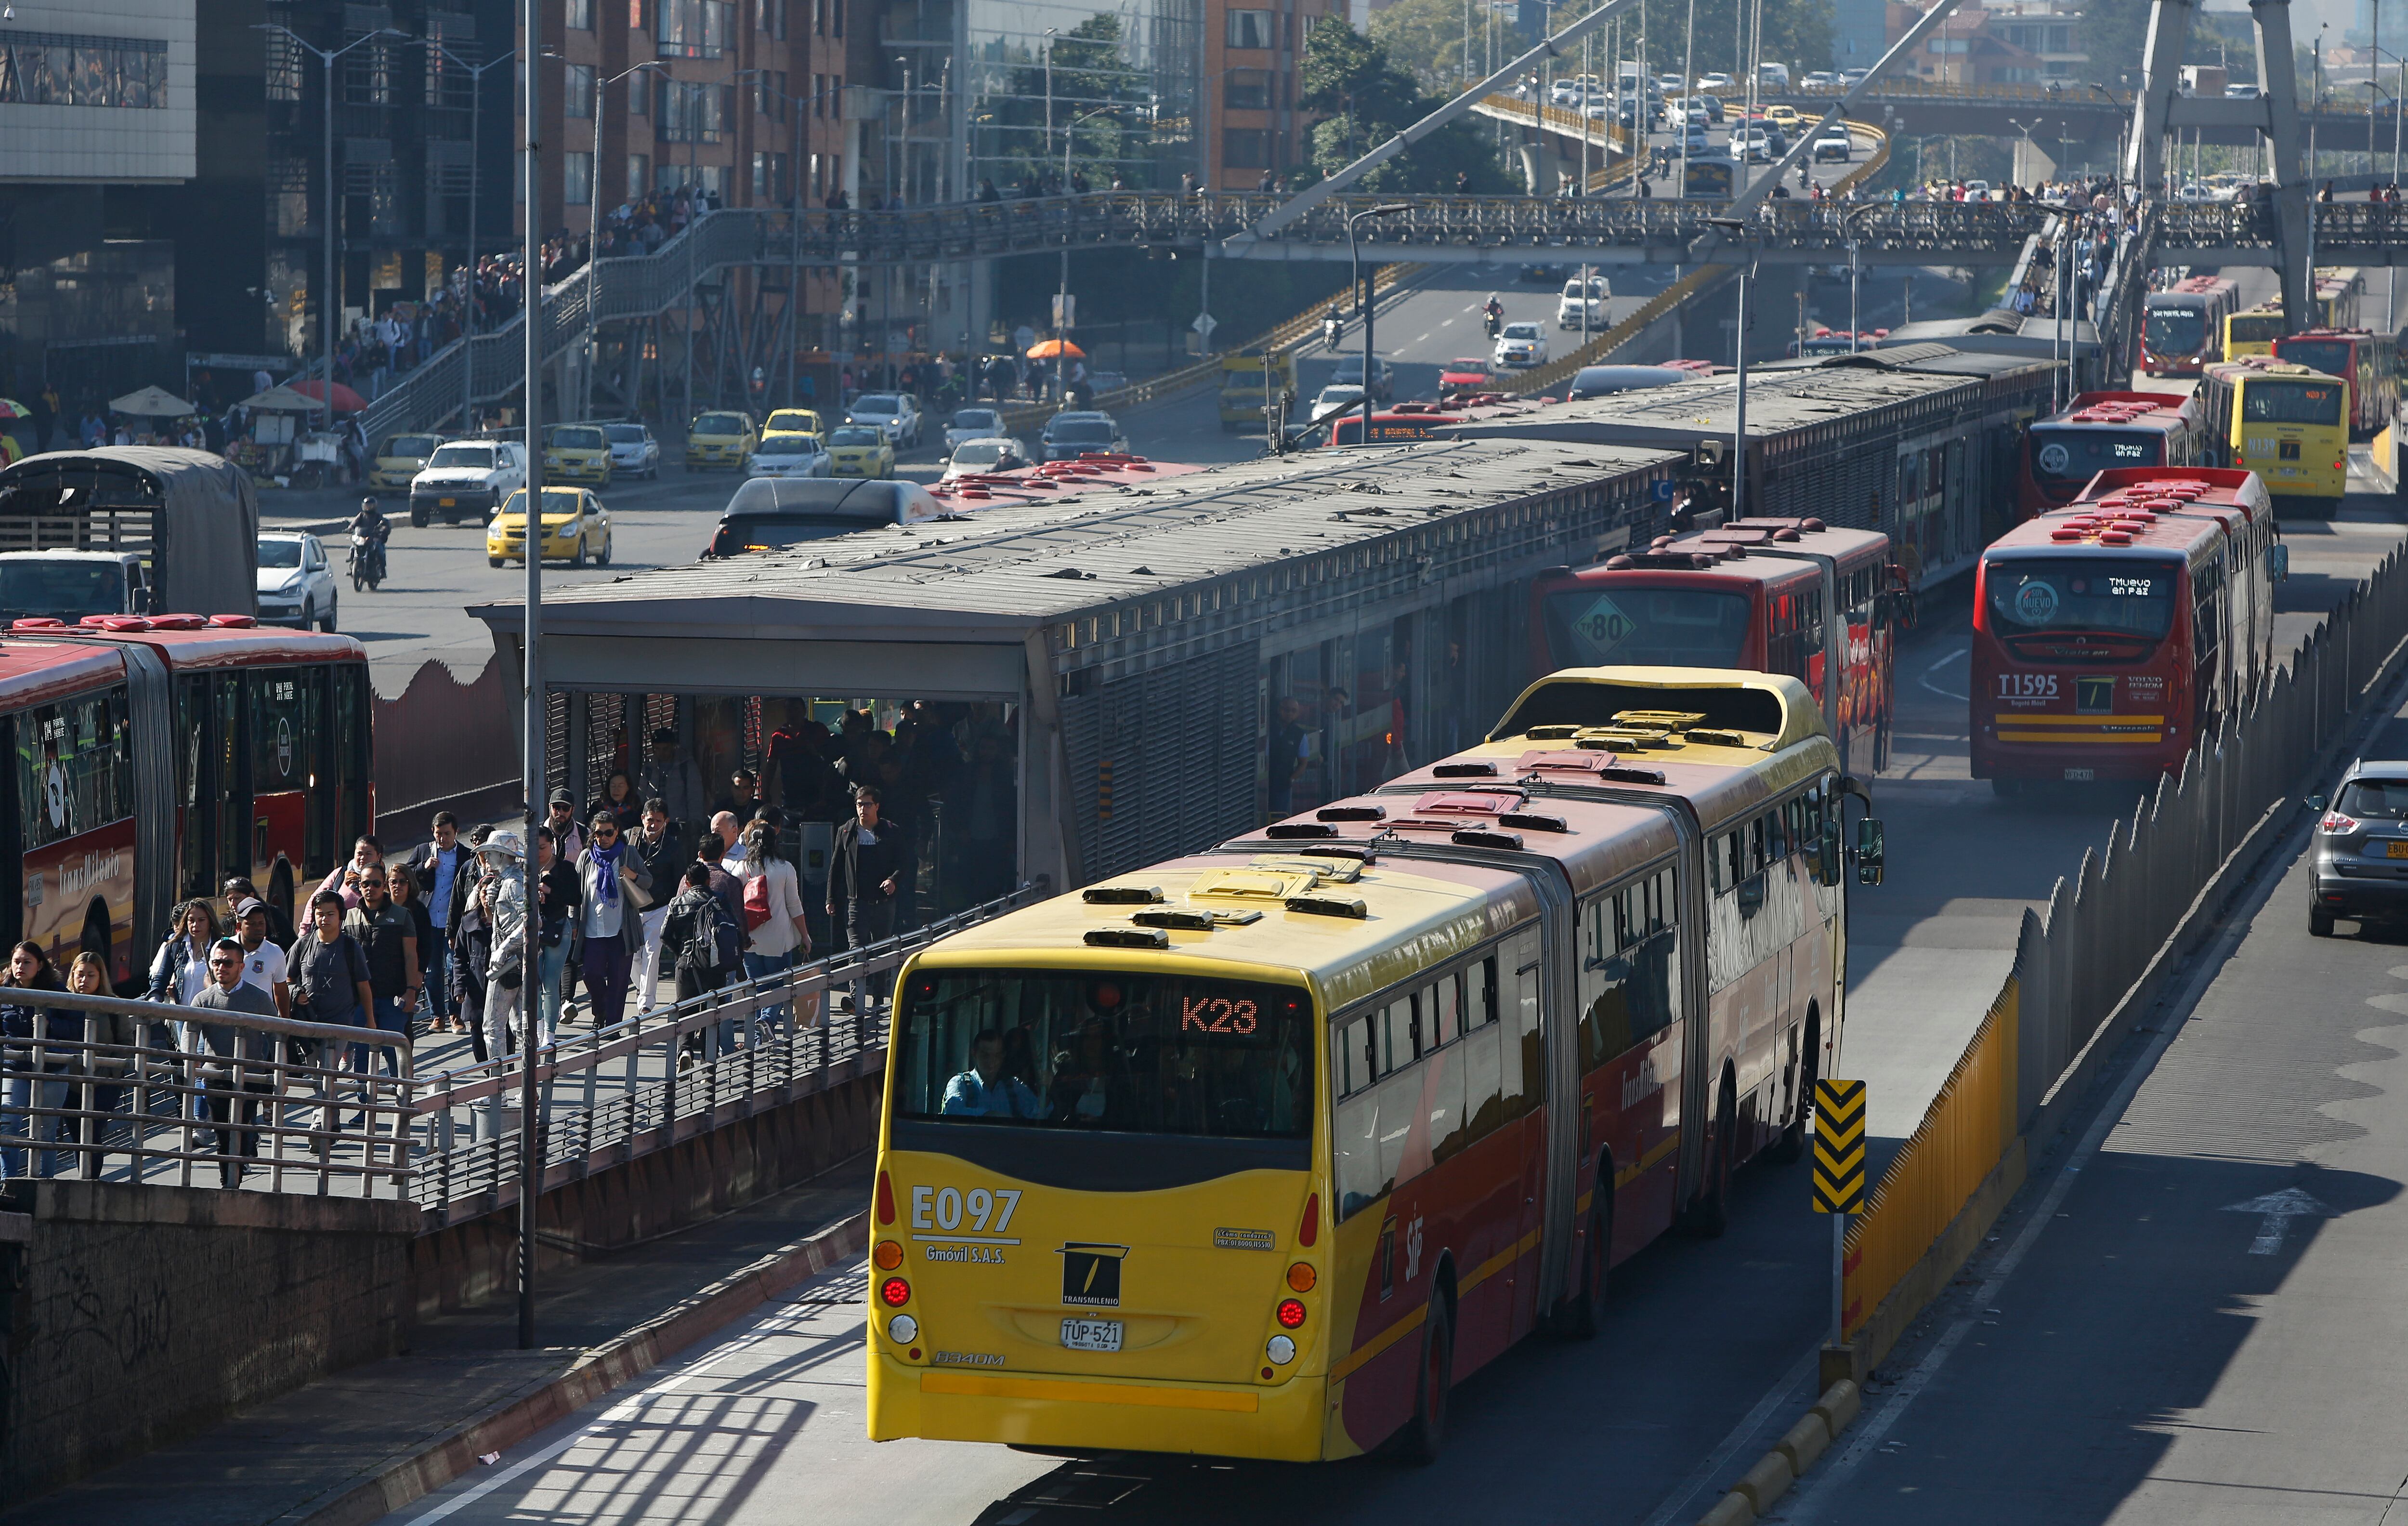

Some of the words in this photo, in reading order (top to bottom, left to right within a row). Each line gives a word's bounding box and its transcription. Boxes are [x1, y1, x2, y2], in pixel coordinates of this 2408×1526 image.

[1658, 482, 1669, 499] C
[2023, 598, 2051, 608] NUEVO
[1999, 674, 2058, 696] T1595
[59, 847, 119, 897] TransMilenio
[1182, 997, 1257, 1034] K23
[911, 1185, 1023, 1233] E097
[926, 1245, 968, 1263] Gmóvil
[971, 1247, 1006, 1264] S.A.S.
[1063, 1296, 1119, 1305] TRANSMILENIO
[1063, 1324, 1118, 1343] TUP-521
[935, 1351, 1006, 1367] B340M
